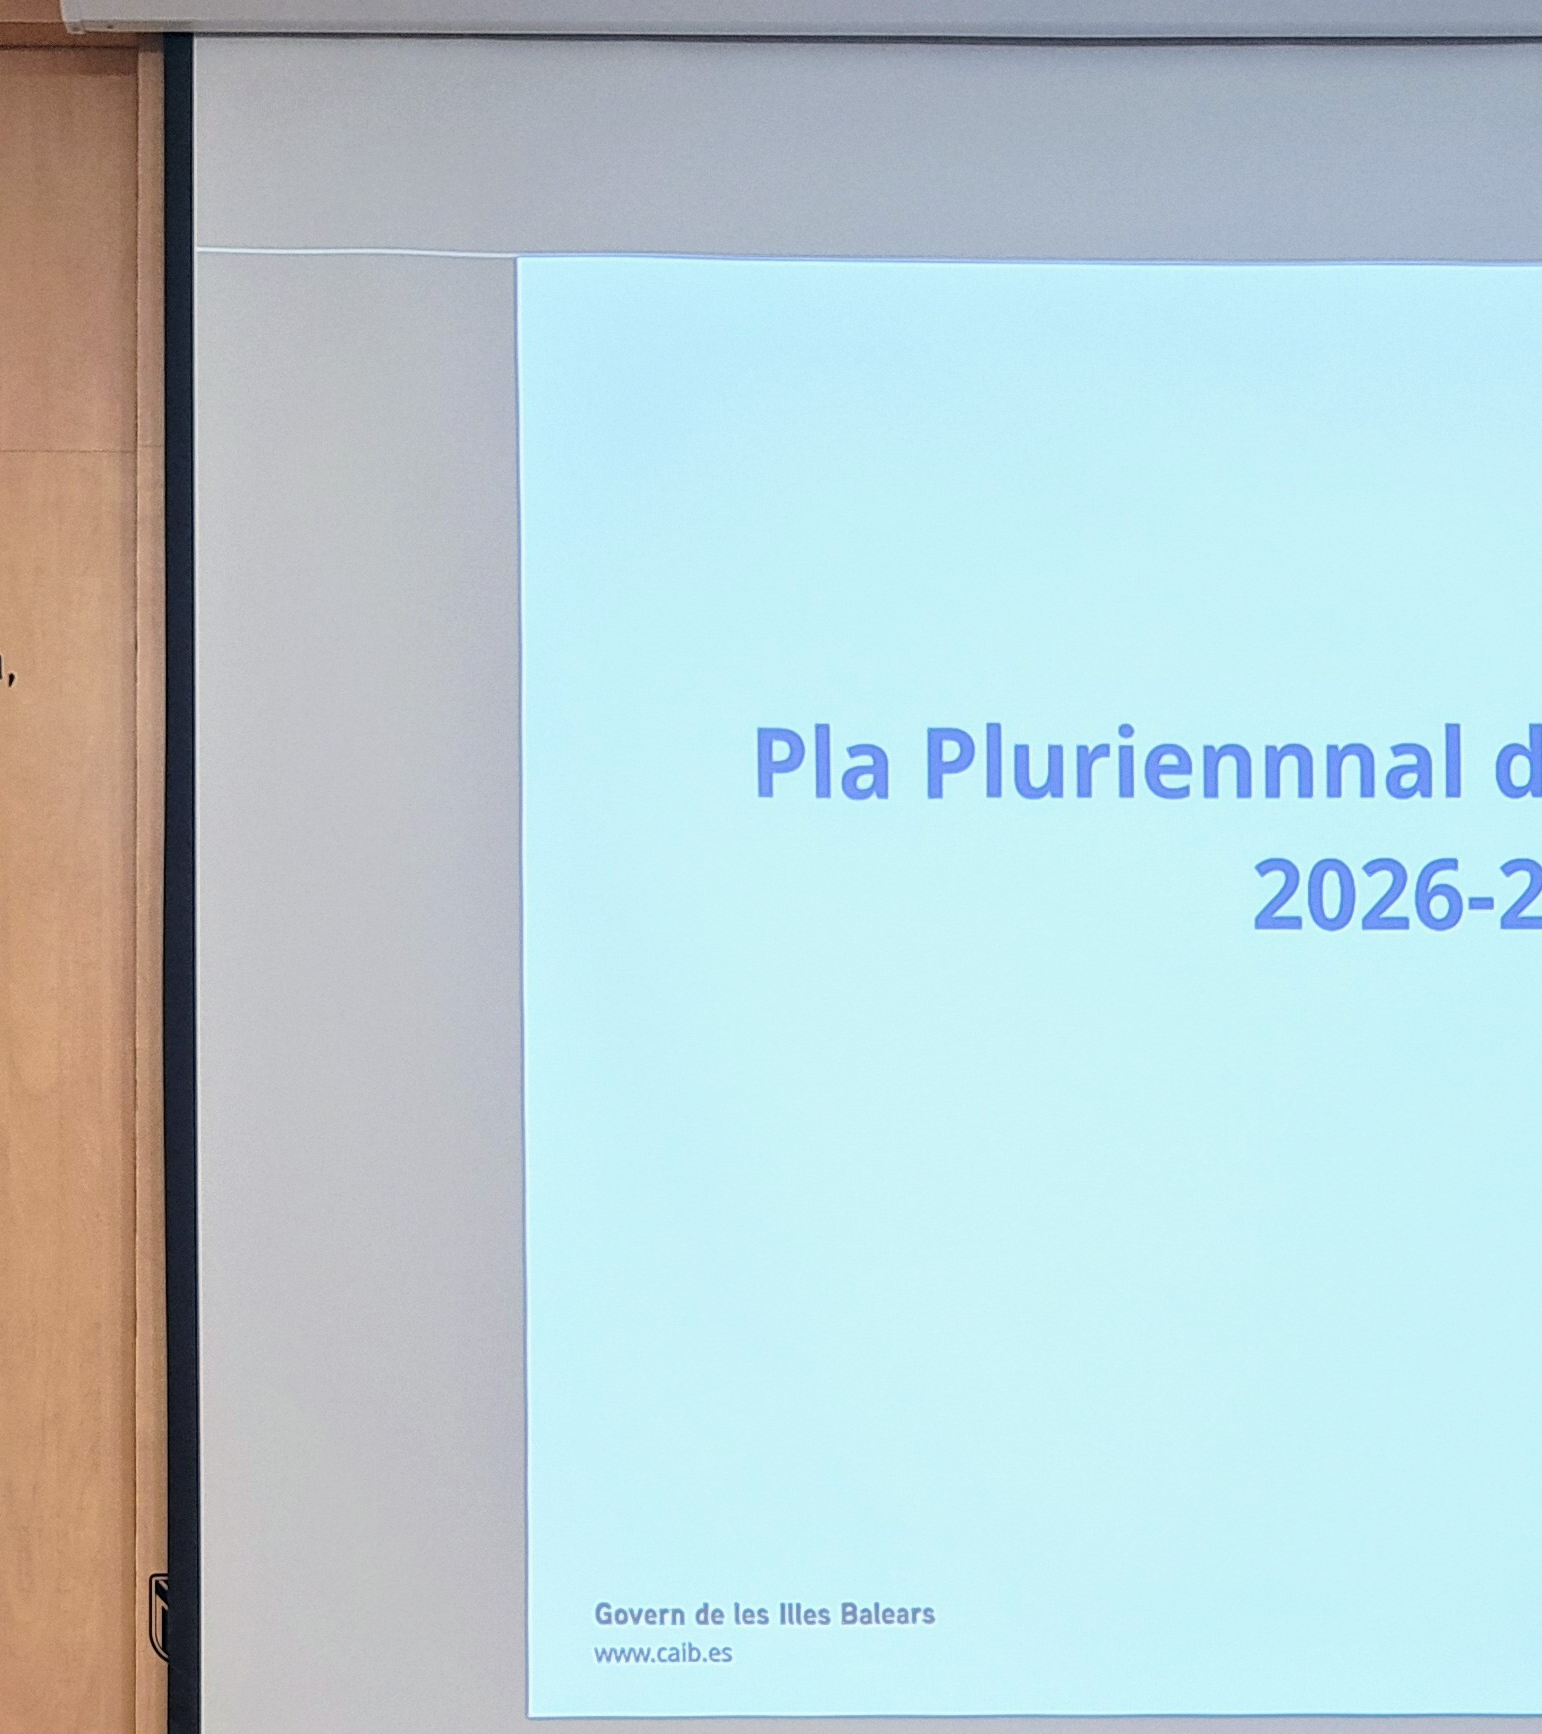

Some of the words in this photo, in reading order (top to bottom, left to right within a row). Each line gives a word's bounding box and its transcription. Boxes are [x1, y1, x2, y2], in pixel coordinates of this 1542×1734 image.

[756, 722, 890, 801] Pla
[925, 721, 1462, 801] Pluriennnal
[595, 1601, 685, 1626] Govern
[695, 1602, 725, 1626] de
[733, 1601, 770, 1625] les
[779, 1602, 831, 1626] Illes
[841, 1601, 936, 1625] Balears
[593, 1641, 733, 1664] www.caib.es
